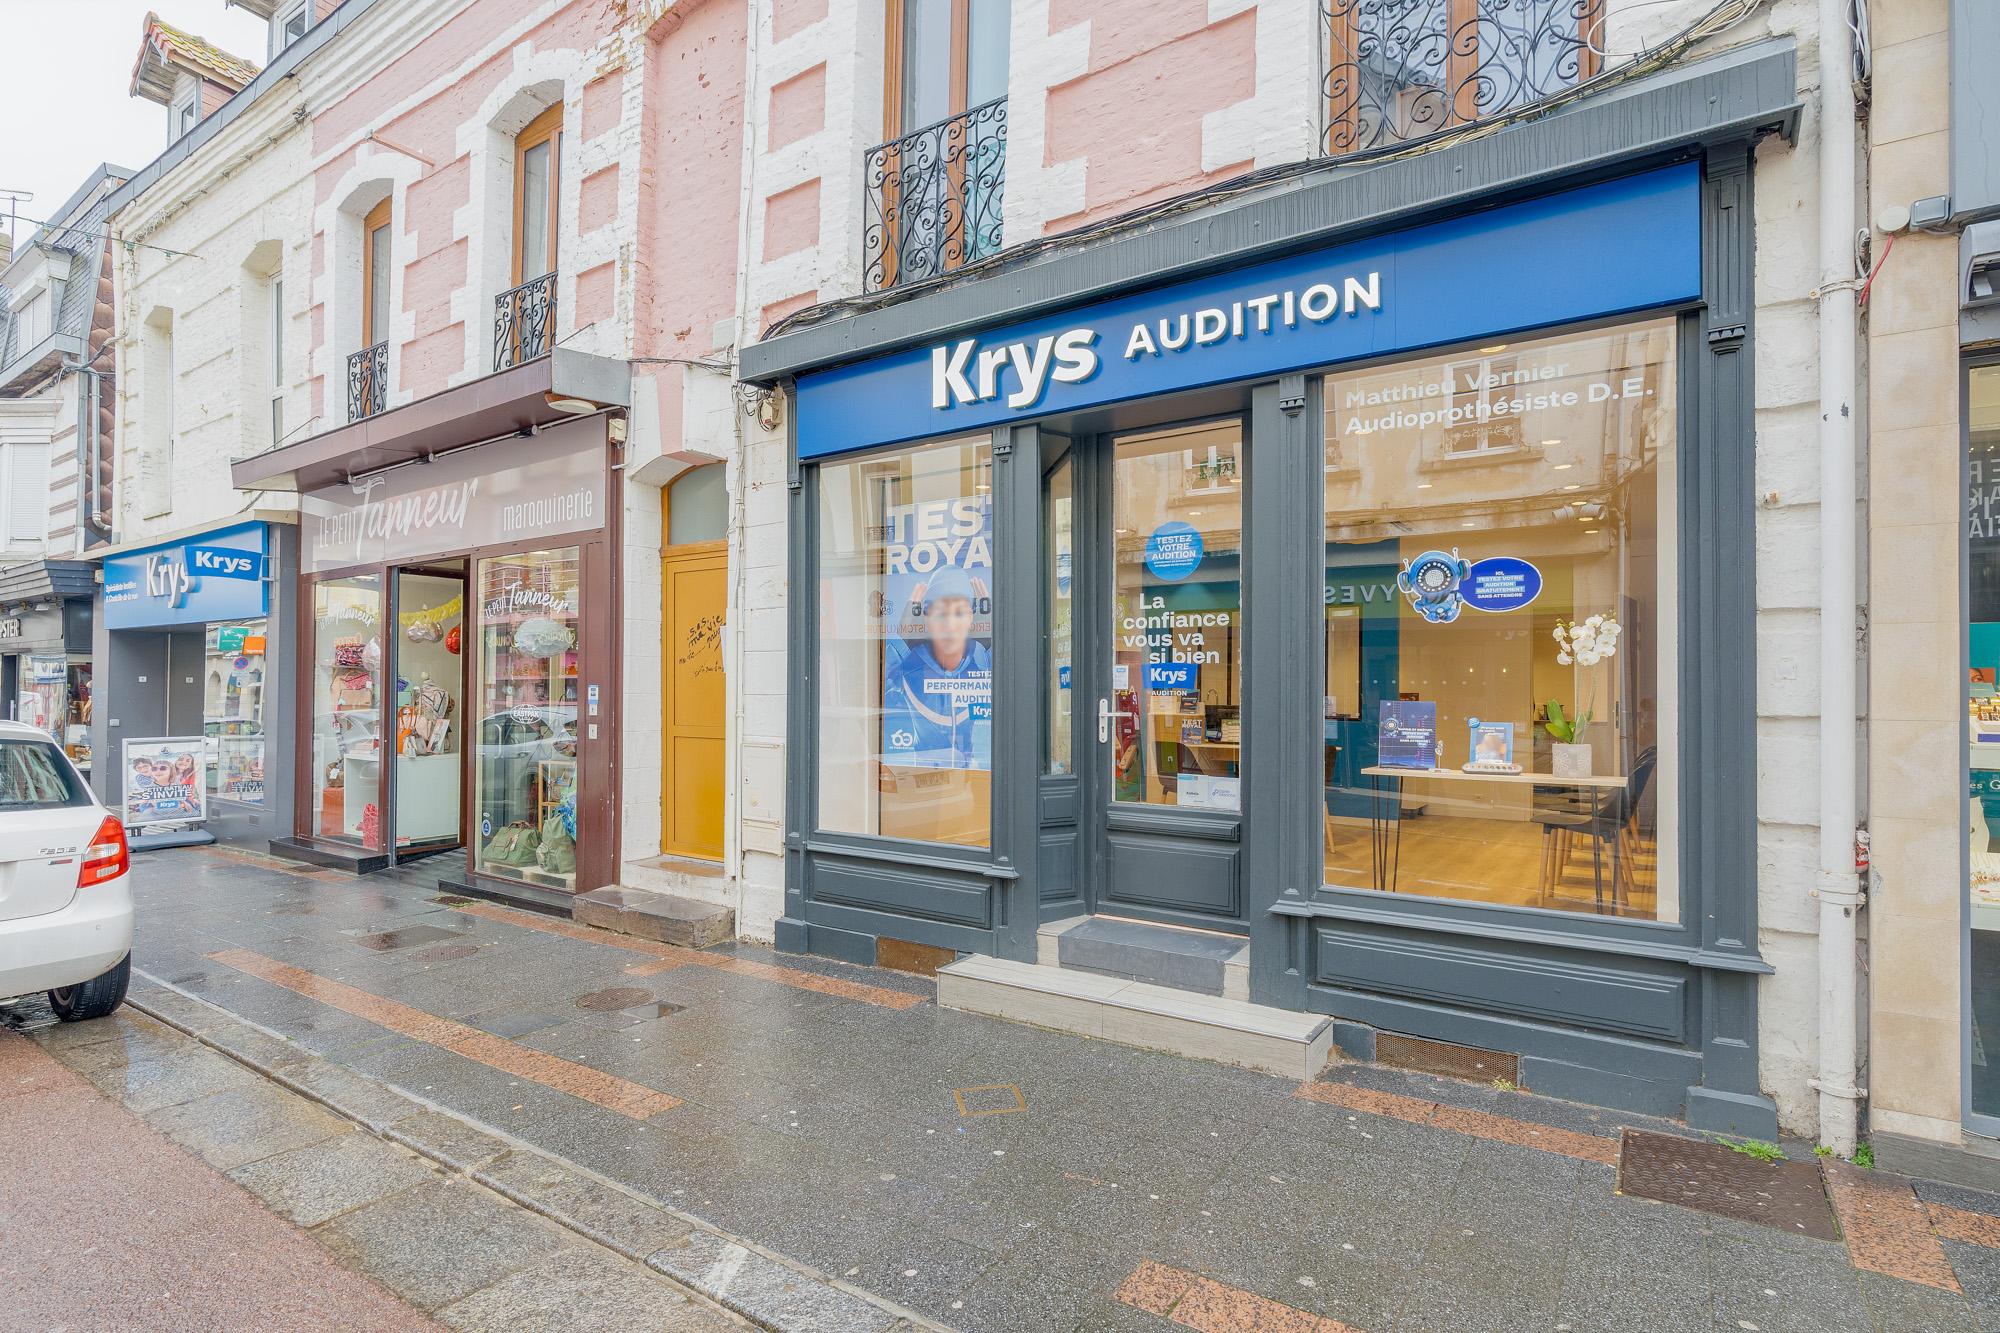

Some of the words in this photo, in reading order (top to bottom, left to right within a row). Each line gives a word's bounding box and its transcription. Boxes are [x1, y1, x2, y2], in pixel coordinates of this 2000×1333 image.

[931, 327, 1099, 411] Krys
[1123, 270, 1382, 361] AUDITION
[1346, 378, 1456, 409] Matthieu
[1464, 362, 1569, 391] Vernier
[1344, 389, 1579, 435] Audioprothésiste
[1588, 376, 1655, 403] D.E.
[319, 518, 330, 549] LE
[332, 509, 357, 545] PETIT
[352, 476, 479, 562] Tanneur
[503, 487, 593, 532] maroquinerie
[1156, 534, 1193, 545] TESTEZ
[1158, 542, 1190, 552] VOTRE
[195, 551, 252, 573] Krys
[886, 536, 992, 576] ROYA
[1152, 549, 1196, 561] AUDITION
[145, 554, 190, 609] Krys
[504, 580, 569, 614] Tanneur
[1140, 592, 1165, 610] La
[1123, 611, 1230, 630] confiance
[1123, 633, 1173, 647] vous
[1178, 631, 1205, 646] va
[1149, 648, 1166, 664] si
[1172, 648, 1220, 664] bien
[1150, 668, 1187, 685] Krys
[513, 709, 540, 718] EASTPAK
[142, 788, 192, 800] S'INVITE
